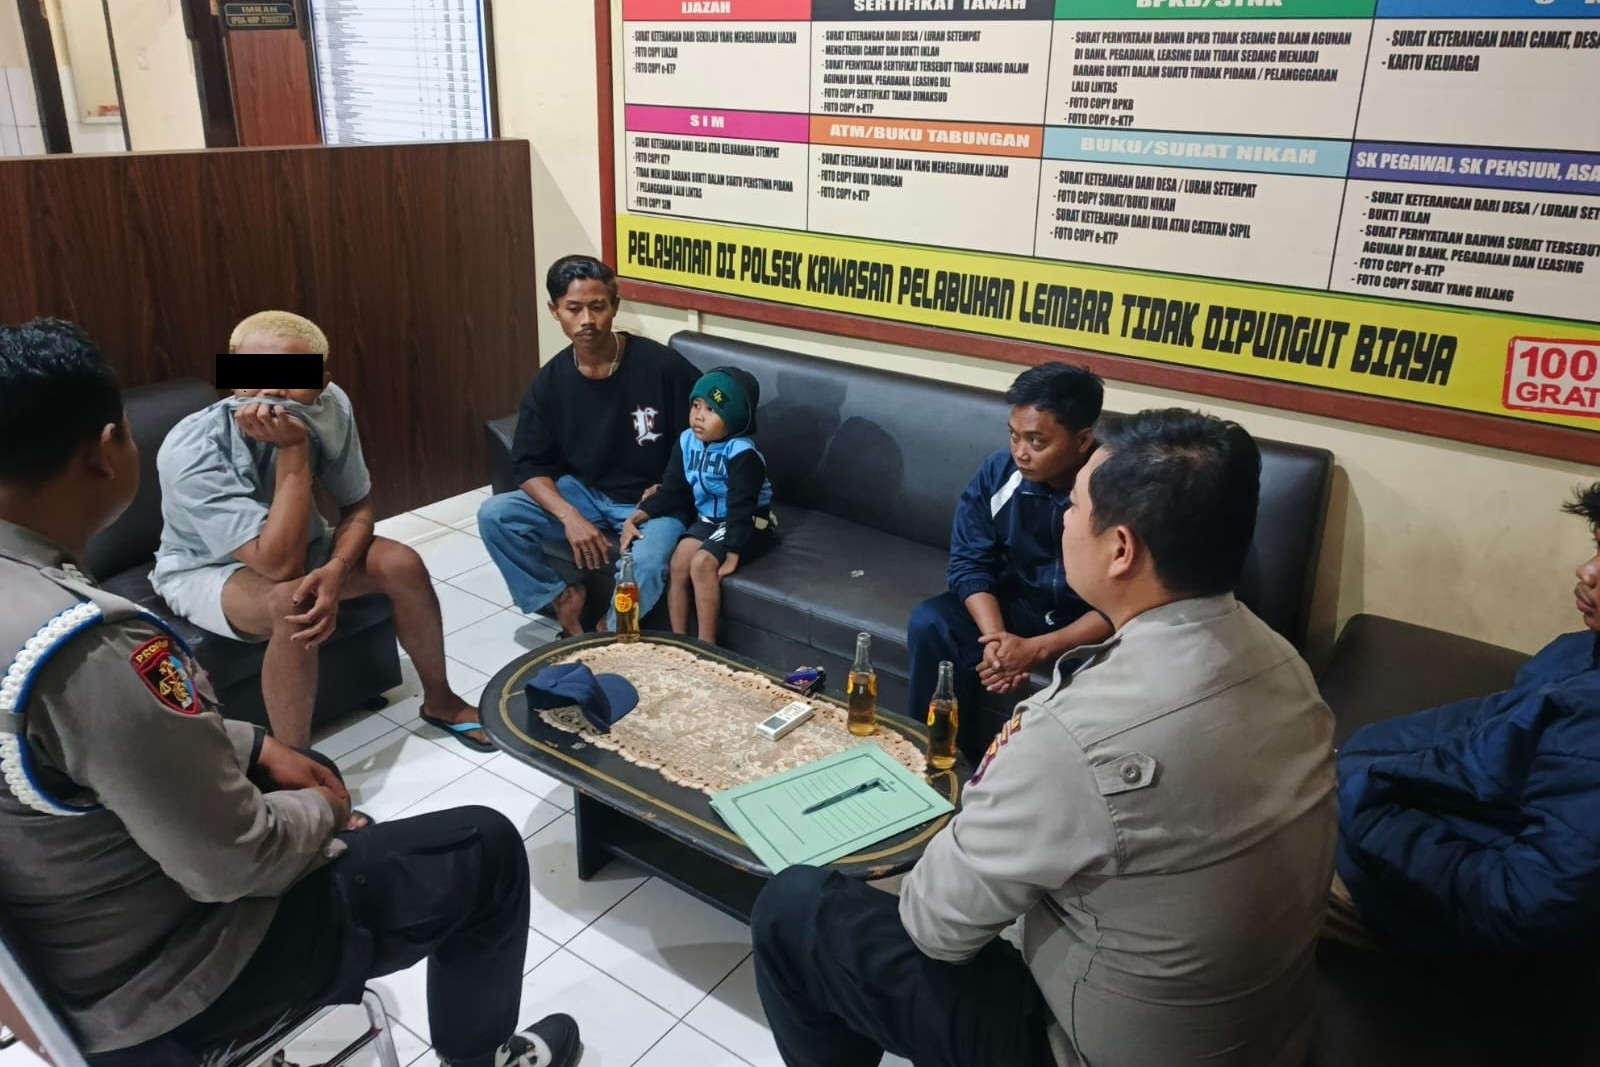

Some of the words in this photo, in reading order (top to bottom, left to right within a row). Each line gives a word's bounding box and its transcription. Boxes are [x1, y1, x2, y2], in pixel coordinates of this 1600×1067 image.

[682, 2, 730, 13] IJAZAH
[854, 0, 953, 11] SERTIFIKAT
[963, 0, 1026, 10] TANAH
[826, 31, 844, 40] SURAT
[846, 31, 884, 41] KETERANGAN
[886, 31, 900, 41] DARI
[902, 31, 918, 41] DESA
[924, 31, 945, 41] LURAH
[947, 31, 980, 41] SETEMPAT
[1076, 32, 1100, 43] SURAT
[1102, 32, 1152, 43] PERNYATAAN
[1154, 32, 1184, 43] BAHWA
[1187, 32, 1210, 43] BPKB
[1212, 32, 1238, 44] TIDAK
[1240, 33, 1276, 44] SEDANG
[1278, 33, 1309, 44] DALAM
[1312, 33, 1352, 44] AGUNAN
[1392, 30, 1426, 47] SURAT
[1428, 30, 1498, 47] KETERANGAN
[1500, 31, 1527, 48] DARI
[1529, 31, 1571, 50] CAMAT,
[1075, 49, 1083, 59] DI
[1084, 49, 1107, 60] BANK,
[1109, 49, 1155, 60] PEGADAIAN,
[1157, 50, 1191, 61] LEASING
[1193, 50, 1210, 61] DAN
[1213, 50, 1239, 61] TIDAK
[1241, 50, 1276, 62] SEDANG
[1278, 51, 1318, 62] MENJADI
[1388, 54, 1422, 70] KARTU
[1424, 55, 1480, 71] KELUARGA
[825, 60, 843, 70] SURAT
[845, 60, 881, 70] PERNYATAAN
[884, 61, 918, 71] SERTIFIKAT
[920, 61, 951, 72] TERSEBUT
[954, 62, 973, 72] TIDAK
[975, 62, 1002, 73] SEDANG
[1004, 63, 1029, 73] DALAM
[1073, 65, 1104, 77] BARANG
[1106, 66, 1130, 77] BUKTI
[1132, 66, 1159, 78] DALAM
[1161, 67, 1188, 78] SUATU
[1190, 67, 1222, 79] TINDAK
[1224, 68, 1256, 80] PIDANA
[1264, 68, 1338, 82] PELANGGGARAN
[1072, 82, 1089, 92] LALU
[1091, 82, 1117, 93] LINTAS
[824, 102, 838, 112] FOTO
[840, 103, 855, 113] COPY
[856, 103, 874, 113] e-KTP
[1070, 98, 1088, 109] FOTO
[1090, 98, 1110, 109] COPY
[1112, 99, 1133, 110] BPKB
[1068, 114, 1087, 125] FOTO
[1089, 114, 1109, 125] COPY
[1111, 115, 1134, 126] e-KTP
[830, 124, 922, 141] ATM/BUKU
[927, 129, 1029, 147] TABUNGAN
[1081, 137, 1233, 159] BUKU/SURAT
[1236, 145, 1317, 164] NIKAH
[1356, 152, 1378, 169] SK
[1380, 153, 1455, 173] PEGAWAI,
[1459, 157, 1481, 175] SK
[1485, 159, 1561, 180] PENSIUN,
[1059, 170, 1083, 185] SURAT
[1085, 172, 1133, 189] KETERANGAN
[1135, 176, 1154, 190] DARI
[1156, 177, 1176, 192] DESA
[1184, 179, 1212, 195] LURAH
[1213, 181, 1257, 198] SETEMPAT
[821, 186, 834, 198] FOTO
[836, 188, 851, 200] COPY
[852, 189, 869, 201] e-KTP
[1058, 190, 1076, 204] FOTO
[1078, 191, 1098, 205] COPY
[1099, 193, 1148, 209] SURAT/BUKU
[1150, 196, 1176, 211] NIKAH
[1371, 191, 1404, 205] SURAT
[1406, 194, 1472, 211] KETERANGAN
[1474, 198, 1500, 213] DARI
[1502, 200, 1530, 215] DESA
[1541, 203, 1577, 218] LURAH
[1056, 208, 1080, 224] SURAT
[1081, 210, 1130, 228] KETERANGAN
[1131, 214, 1150, 230] DARI
[1152, 216, 1167, 231] KUA
[1169, 217, 1189, 233] ATAU
[1192, 219, 1227, 236] CATATAN
[1229, 223, 1250, 238] SIPIL
[1368, 208, 1399, 222] BUKTI
[1400, 210, 1430, 224] IKLAN
[1055, 227, 1072, 241] FOTO
[1074, 228, 1094, 243] COPY
[1095, 230, 1118, 245] e-KTP
[1365, 225, 1396, 239] SURAT
[1399, 228, 1463, 245] PERNYATAAN
[1465, 233, 1505, 249] BAHWA
[1507, 236, 1543, 252] SURAT
[1363, 242, 1403, 257] AGUNAN
[1405, 245, 1416, 258] DI
[1418, 247, 1448, 261] BANK,
[1451, 249, 1510, 267] PEGADAIAN
[1512, 255, 1535, 269] DAN
[1537, 257, 1584, 274] LEASING
[1360, 258, 1384, 271] FOTO
[1386, 260, 1413, 273] COPY
[1415, 263, 1445, 276] e-KTP
[1357, 274, 1381, 288] FOTO
[1383, 277, 1410, 291] COPY
[1411, 280, 1445, 294] SURAT
[1447, 283, 1472, 297] YANG
[1475, 286, 1514, 302] HILANG
[628, 231, 711, 275] PELAYANAN
[716, 242, 736, 279] DI
[741, 245, 802, 289] POLSEK
[807, 253, 893, 302] KAWASAN
[898, 265, 1015, 320] PELABUHAN
[1019, 286, 1113, 338] LEMBAR
[1120, 297, 1200, 350] TIDAK
[1202, 307, 1350, 371] DIPUNGUT
[1352, 324, 1457, 386] BIAYA
